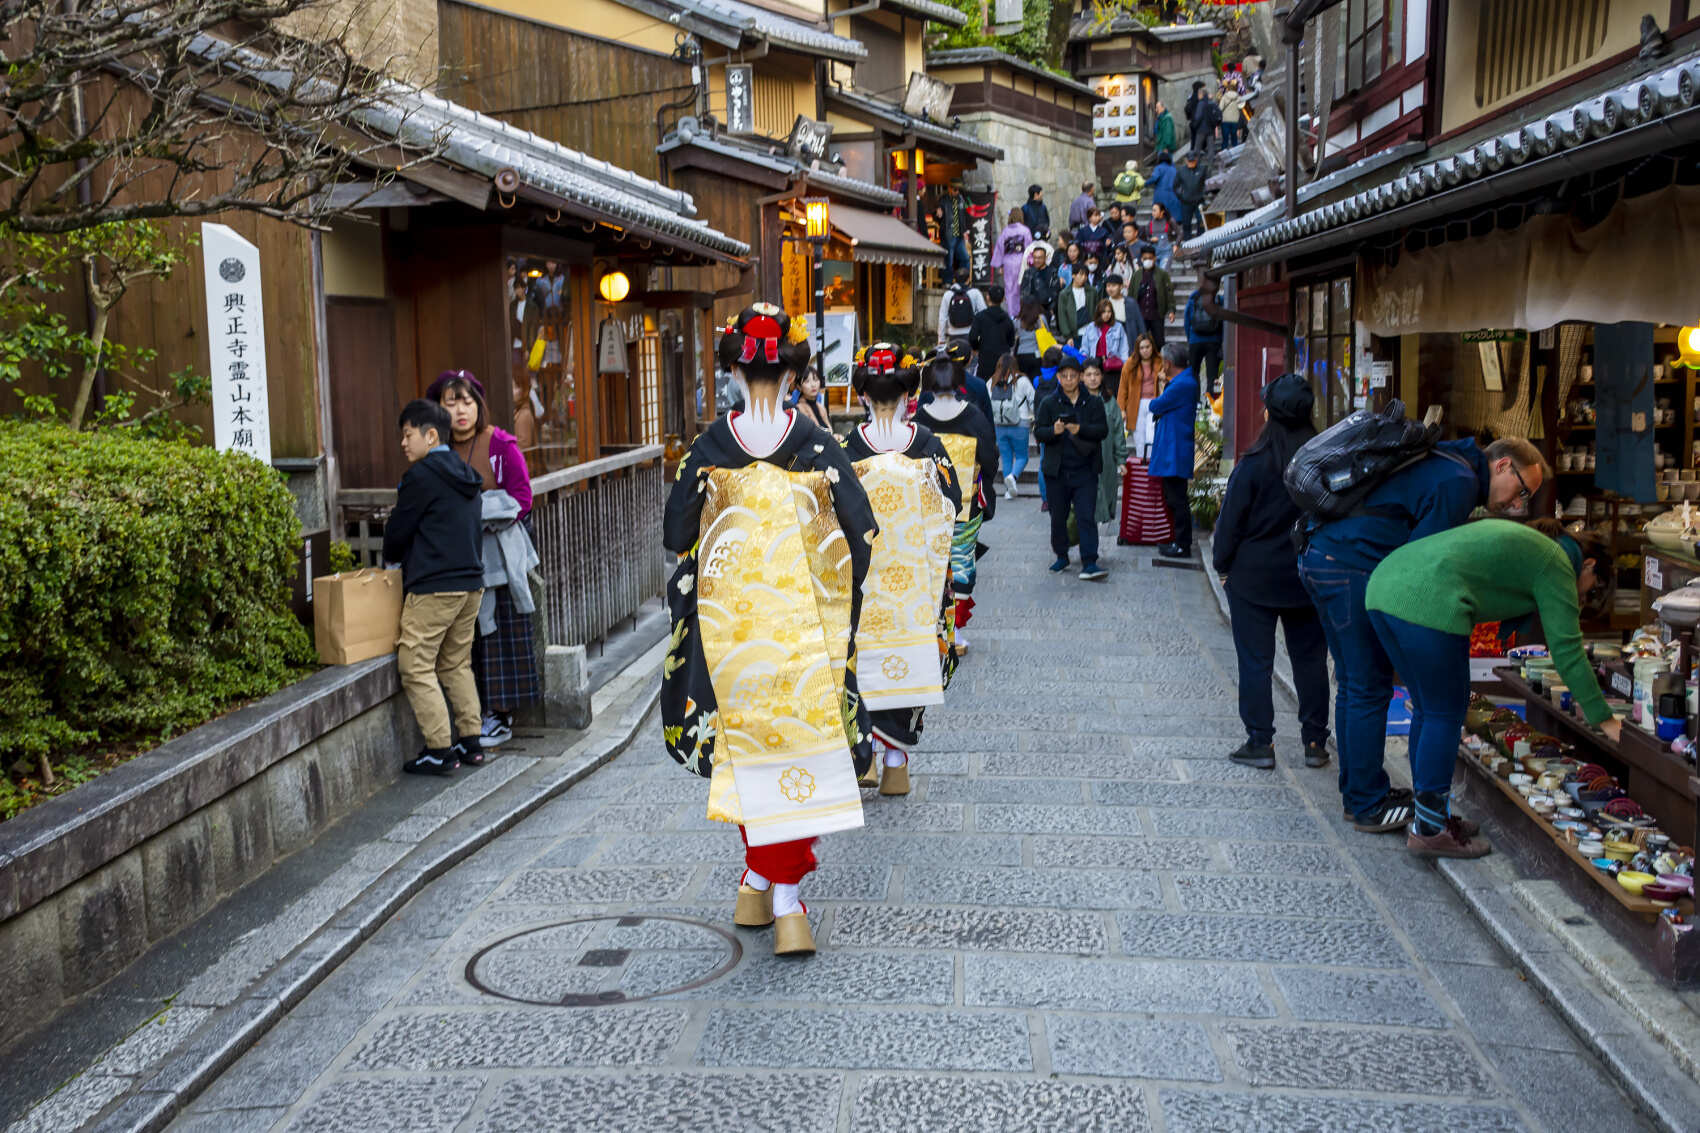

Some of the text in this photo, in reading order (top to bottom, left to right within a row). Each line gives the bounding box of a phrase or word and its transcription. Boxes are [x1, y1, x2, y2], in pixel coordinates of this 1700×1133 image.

[972, 218, 989, 280] 世界一辛い
[223, 292, 253, 448] 興正寺霊山本廟
